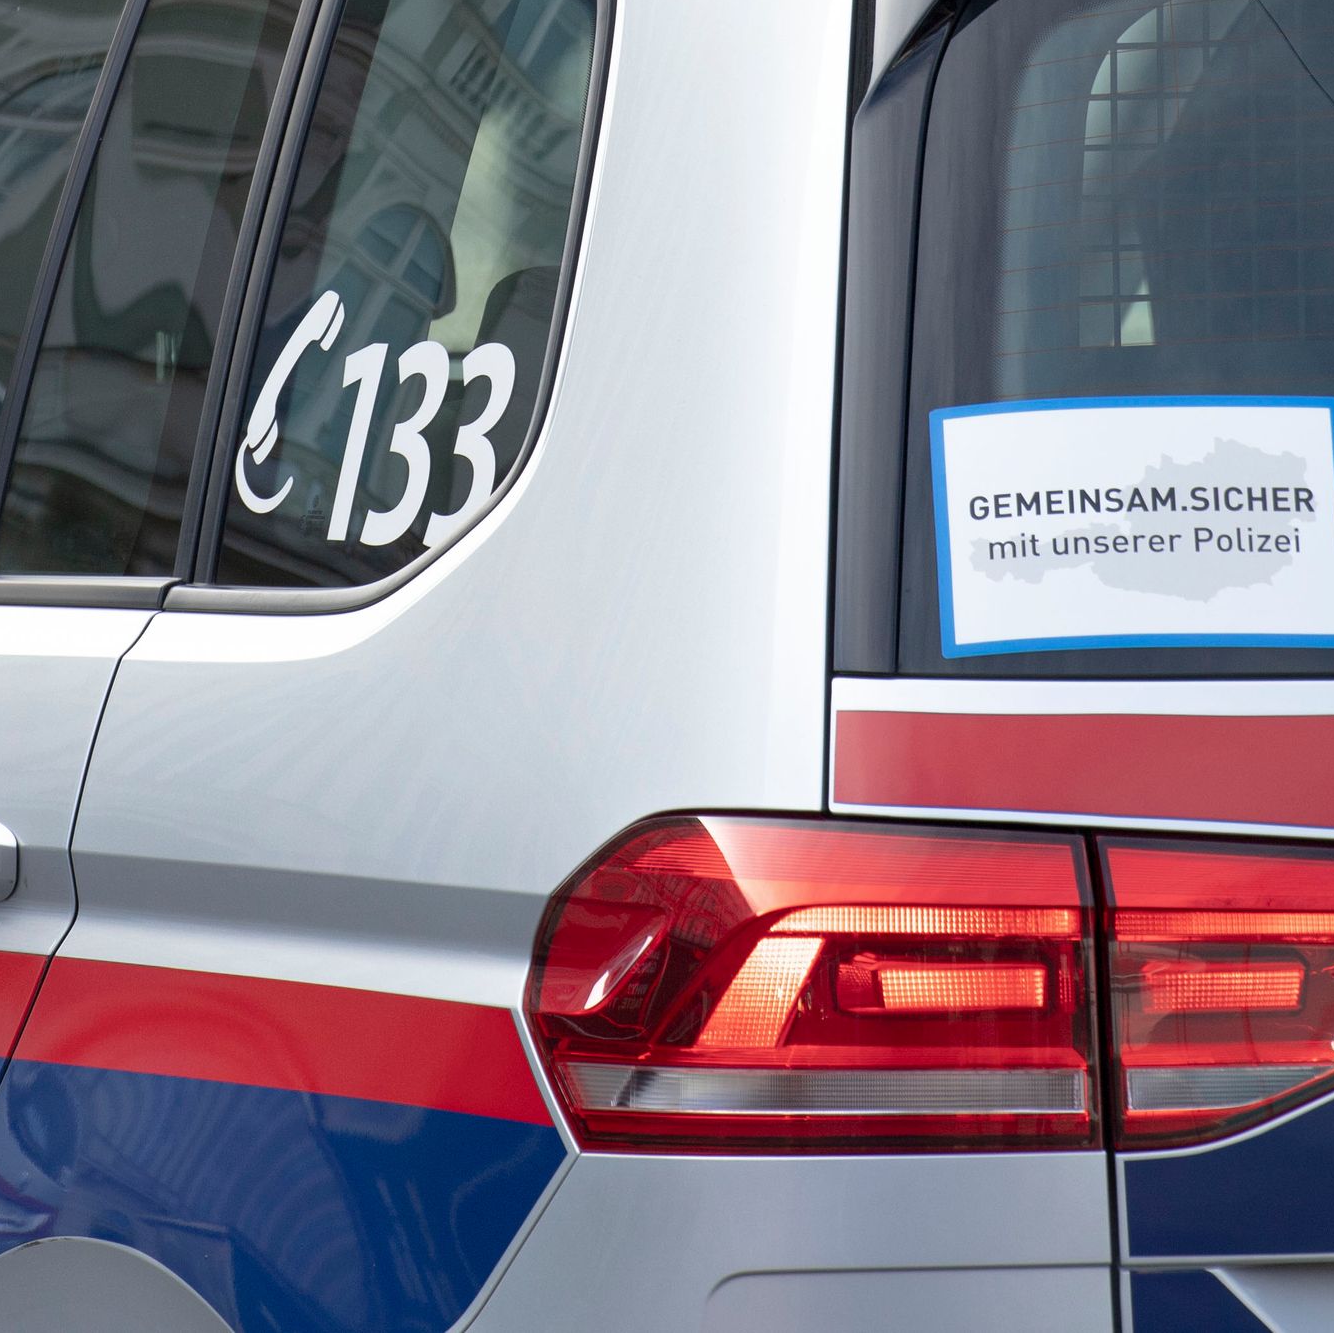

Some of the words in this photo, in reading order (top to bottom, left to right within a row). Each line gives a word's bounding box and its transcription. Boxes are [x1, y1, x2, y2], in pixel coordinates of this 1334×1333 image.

[327, 340, 516, 548] 133
[969, 486, 1315, 520] GEMEINSAM.SICHER
[988, 532, 1040, 560] mit
[1052, 533, 1182, 555] unserer
[1193, 526, 1301, 553] Polizei
